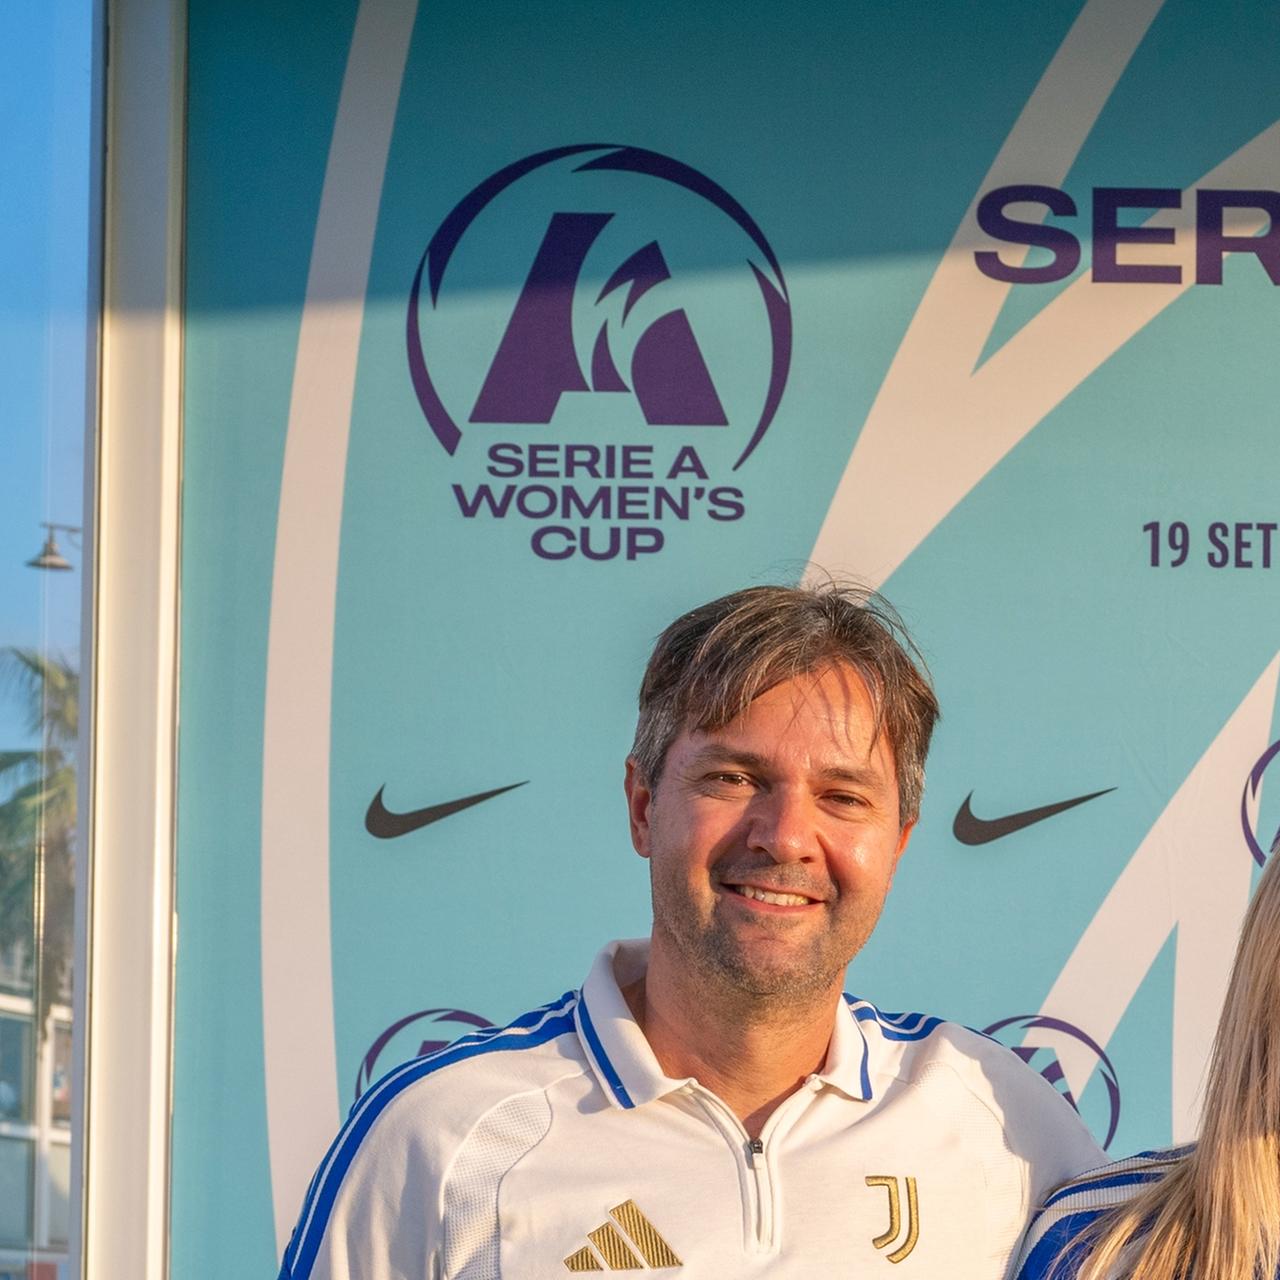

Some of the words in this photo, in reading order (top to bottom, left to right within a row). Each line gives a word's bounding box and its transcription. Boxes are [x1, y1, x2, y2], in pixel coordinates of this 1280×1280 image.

[487, 442, 654, 479] SERIE
[666, 445, 709, 480] A
[451, 483, 745, 522] WOMEN'S
[530, 525, 665, 561] CUP
[1142, 521, 1190, 568] 19
